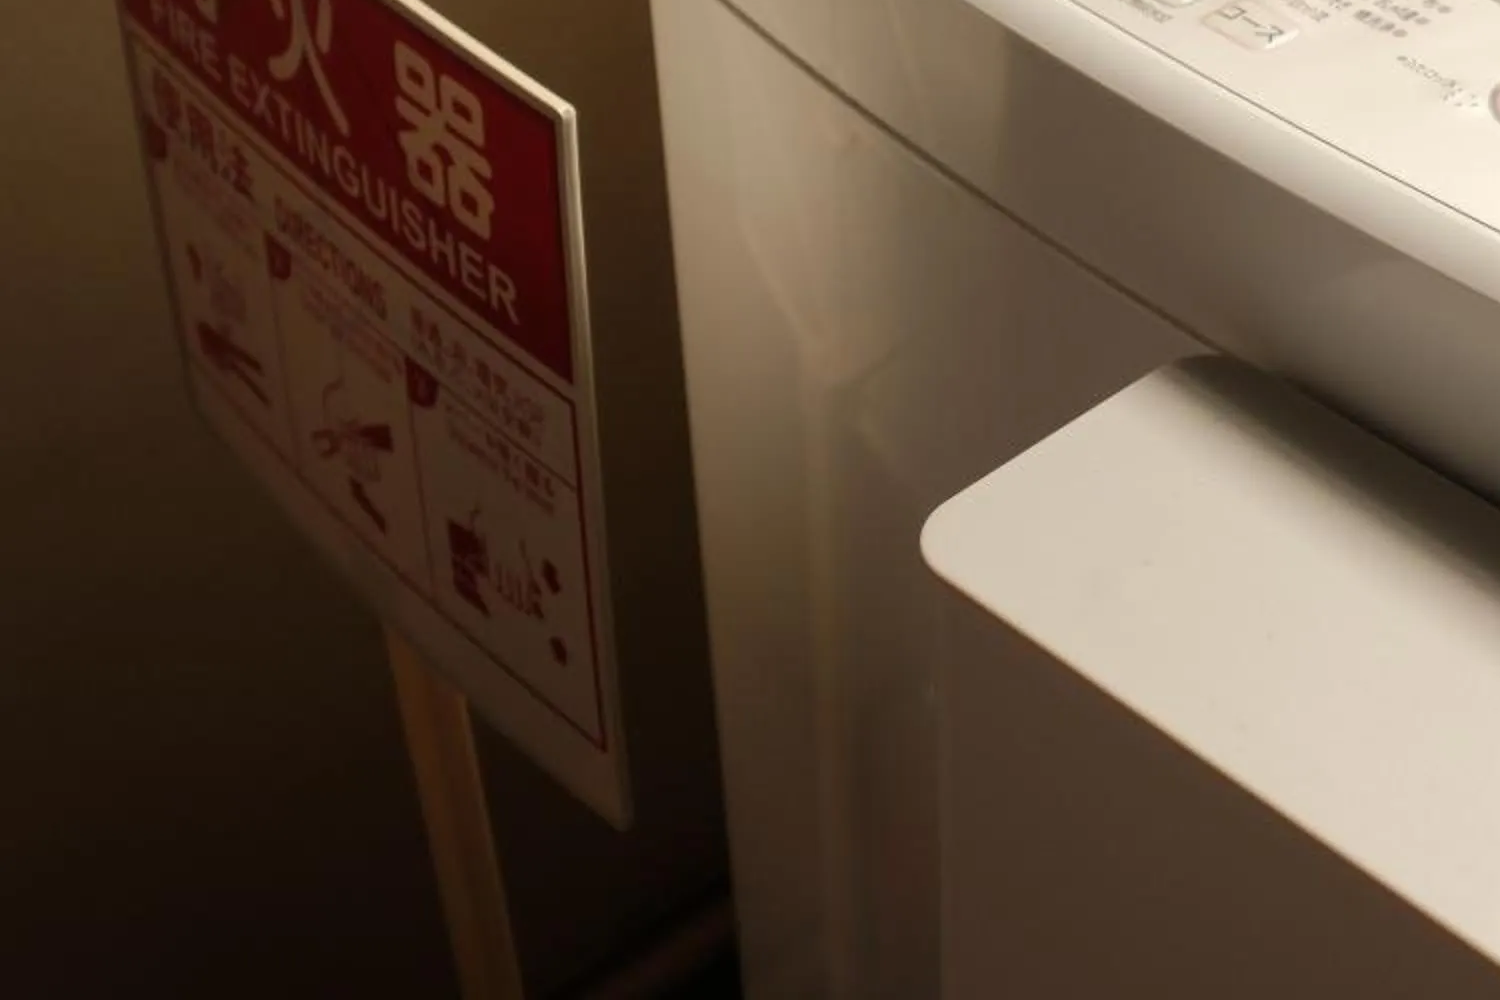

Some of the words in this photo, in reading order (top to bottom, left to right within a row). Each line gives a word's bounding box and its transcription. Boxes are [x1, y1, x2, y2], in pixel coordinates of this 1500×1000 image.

[1216, 5, 1285, 44] コース
[227, 53, 520, 326] EXTINGUISHER
